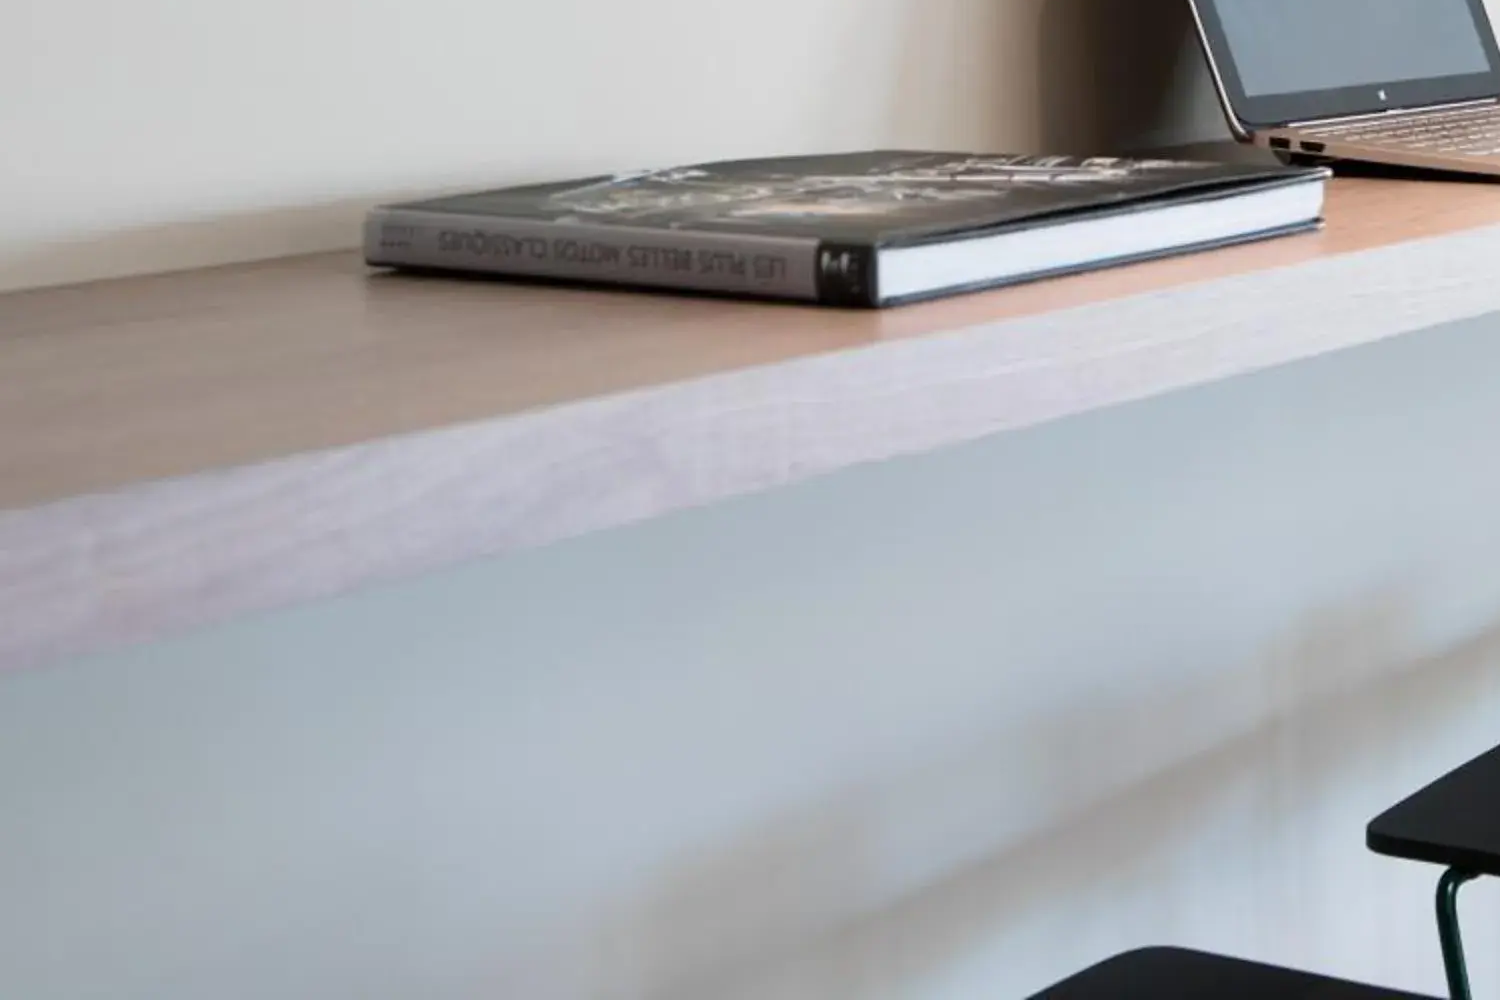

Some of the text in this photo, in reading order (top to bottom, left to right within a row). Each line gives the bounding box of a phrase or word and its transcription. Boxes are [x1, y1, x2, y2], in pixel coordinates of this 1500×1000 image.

[438, 229, 547, 259] CLASSIQUES
[553, 238, 620, 264] MOTOS
[627, 245, 692, 271] BELLES
[700, 252, 746, 276] PLUS
[754, 255, 786, 278] LES
